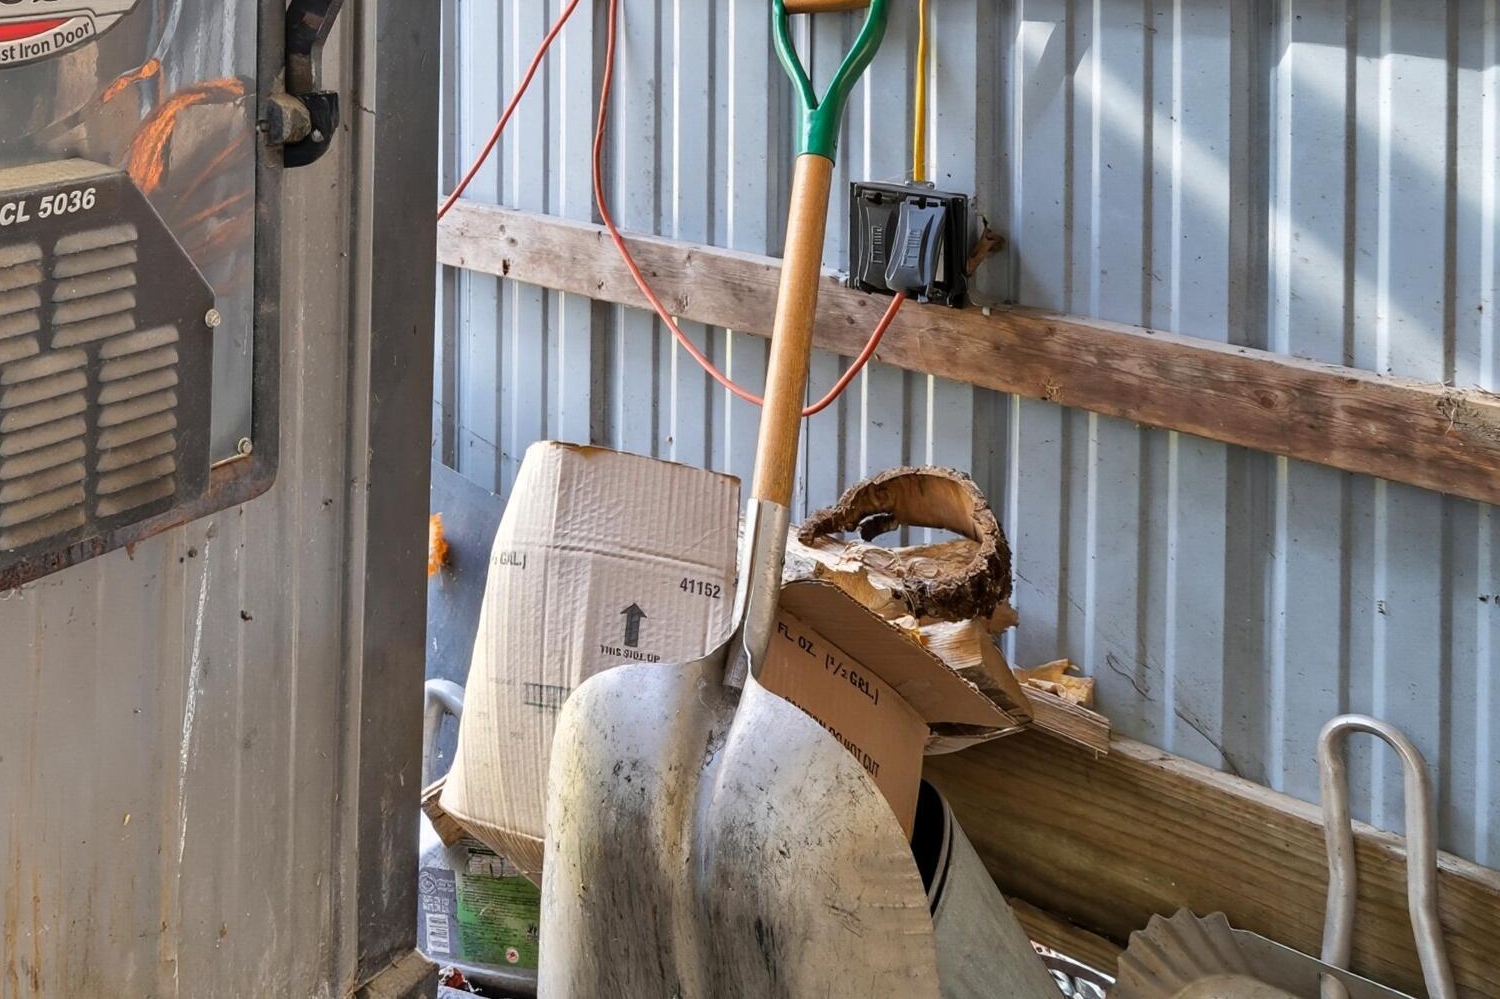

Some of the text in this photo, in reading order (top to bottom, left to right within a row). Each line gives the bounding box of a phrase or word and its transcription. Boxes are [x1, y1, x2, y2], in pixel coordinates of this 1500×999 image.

[19, 37, 50, 60] Iron
[53, 21, 91, 47] Door
[0, 187, 96, 226] CL 5036
[680, 577, 721, 599] 41152
[647, 653, 660, 663] UP
